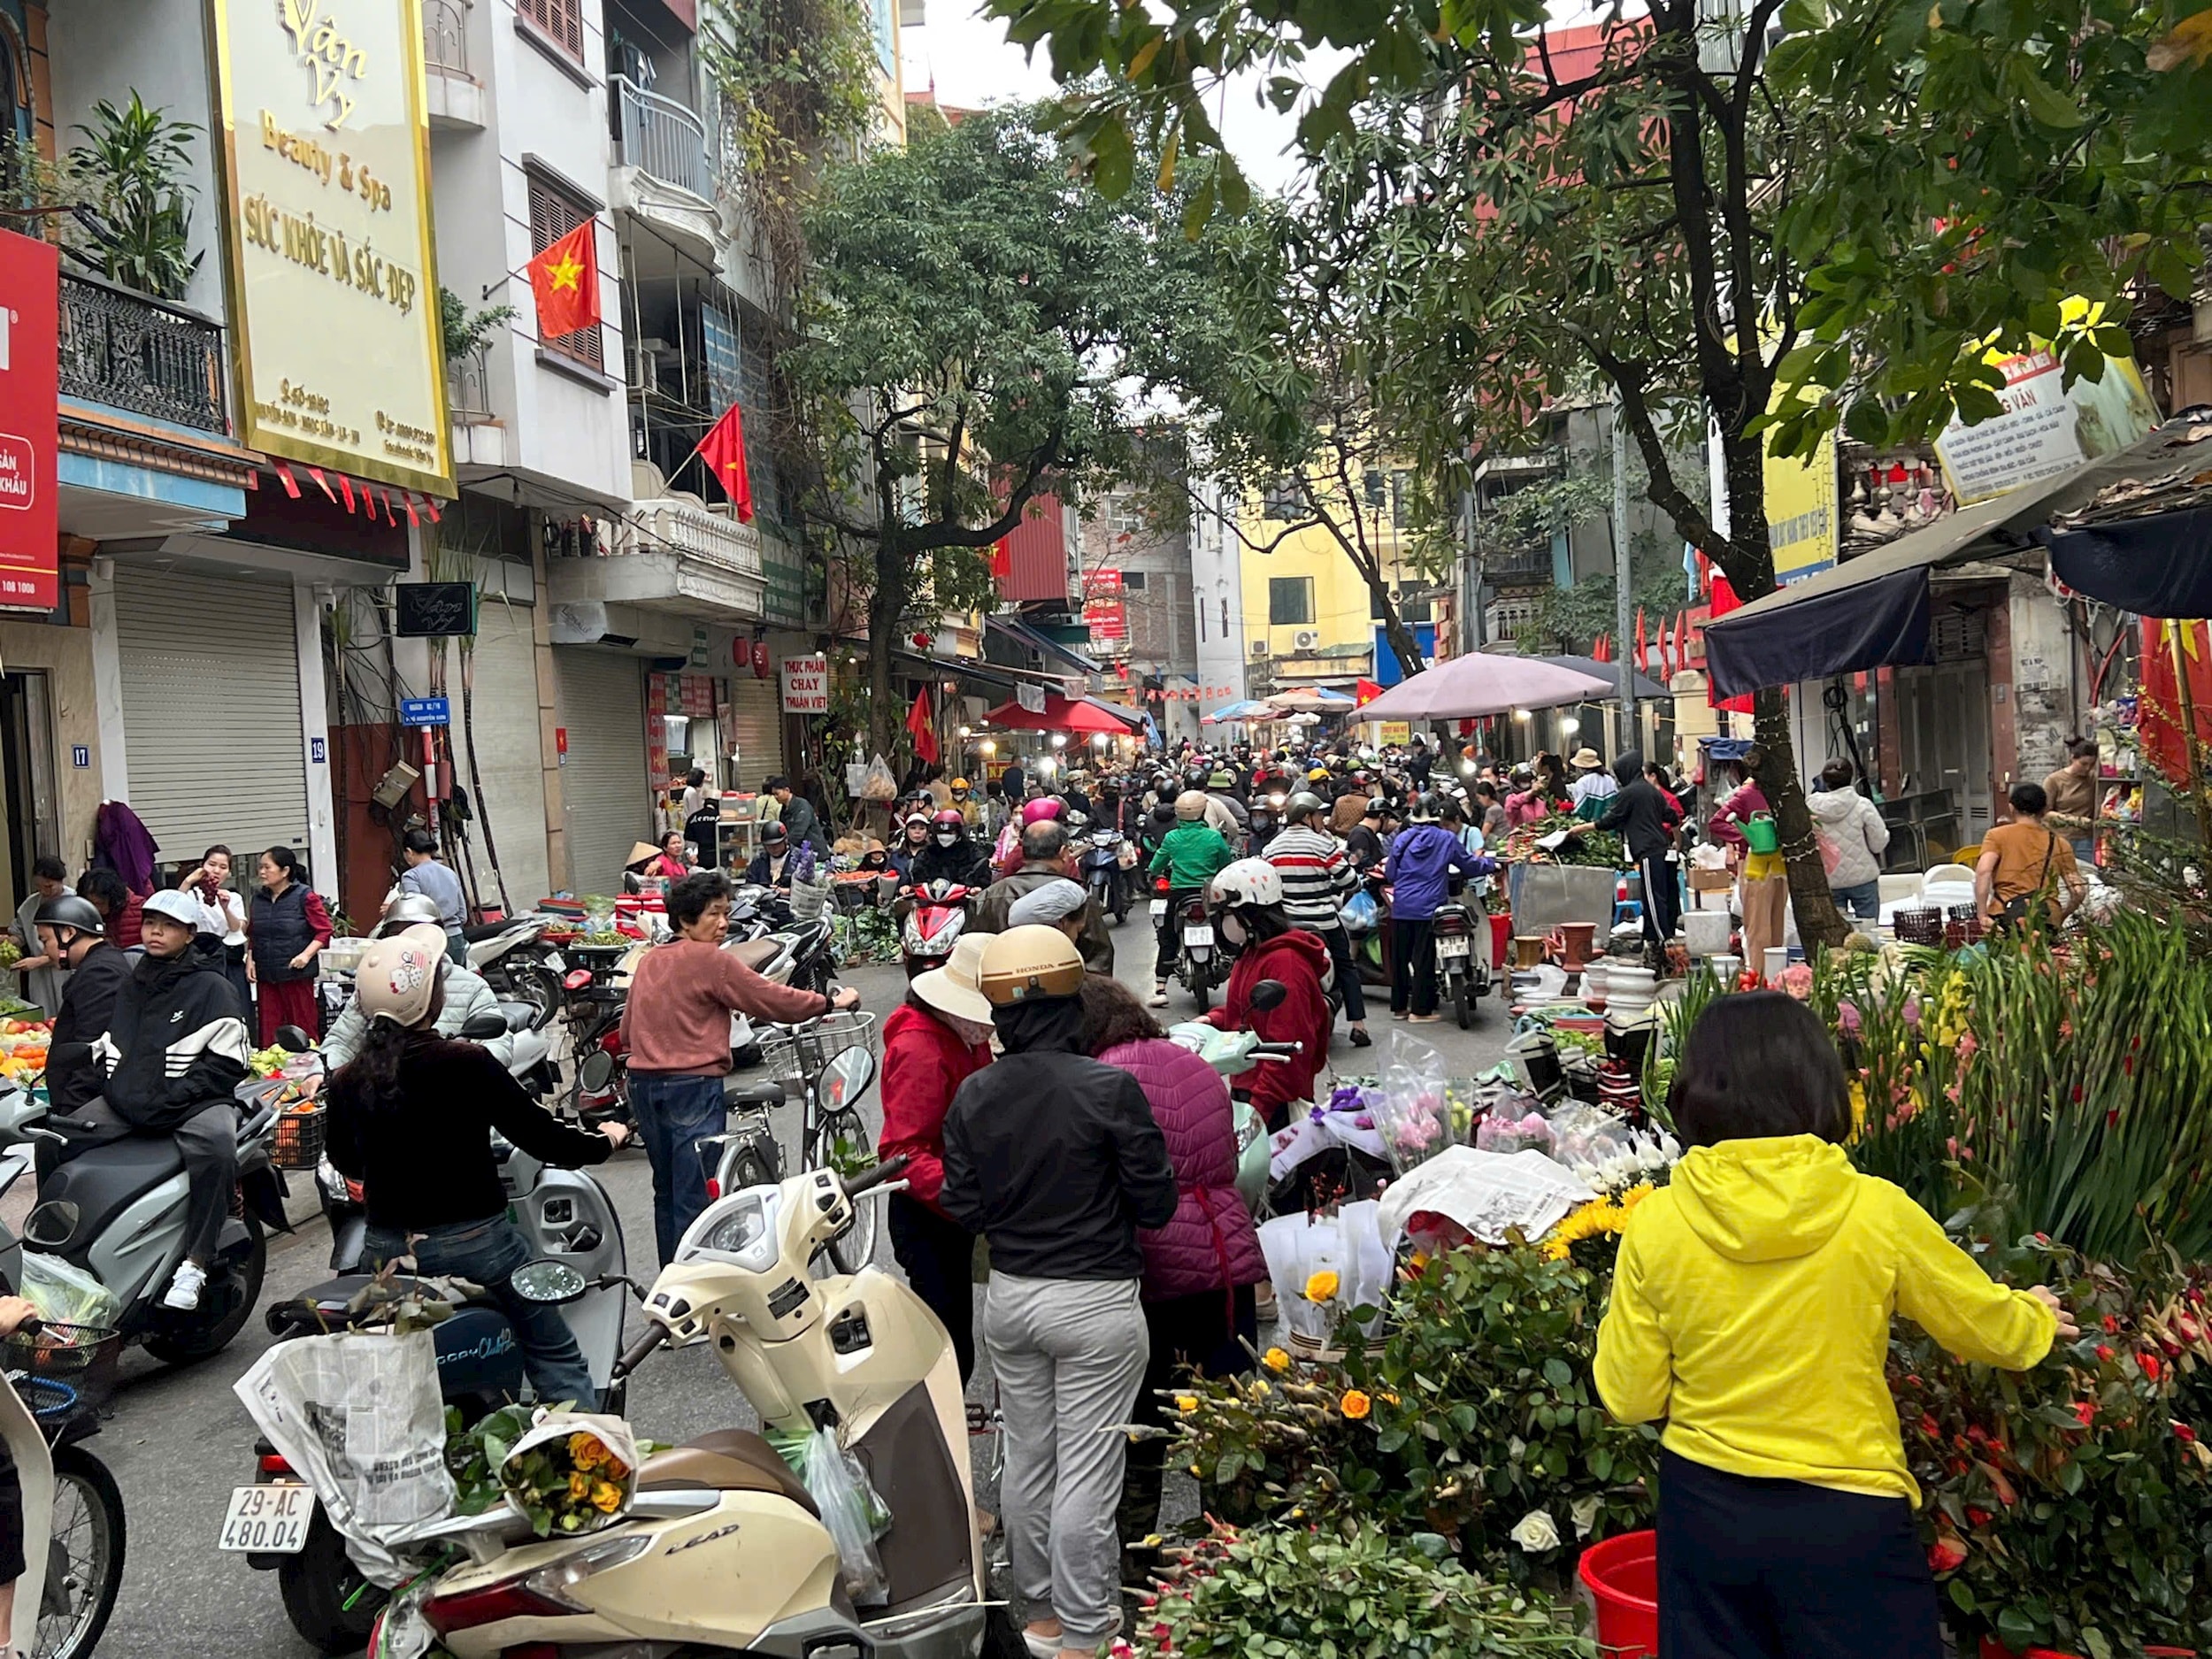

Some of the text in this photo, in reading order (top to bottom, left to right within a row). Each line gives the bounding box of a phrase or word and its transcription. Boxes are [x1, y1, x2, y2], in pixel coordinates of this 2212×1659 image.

[275, 0, 367, 80] Vân
[306, 53, 354, 131] Vy
[260, 109, 392, 212] Beauty & Spa
[244, 193, 415, 317] SỨC KHỎE VÀ SẮC ĐẸP
[790, 678, 819, 691] CHAY
[75, 749, 87, 765] 17
[312, 741, 324, 760] 19
[1016, 963, 1056, 974] HONDA
[237, 1489, 302, 1517] 29-AC
[224, 1519, 299, 1548] 480.04
[664, 1524, 740, 1555] LEAD
